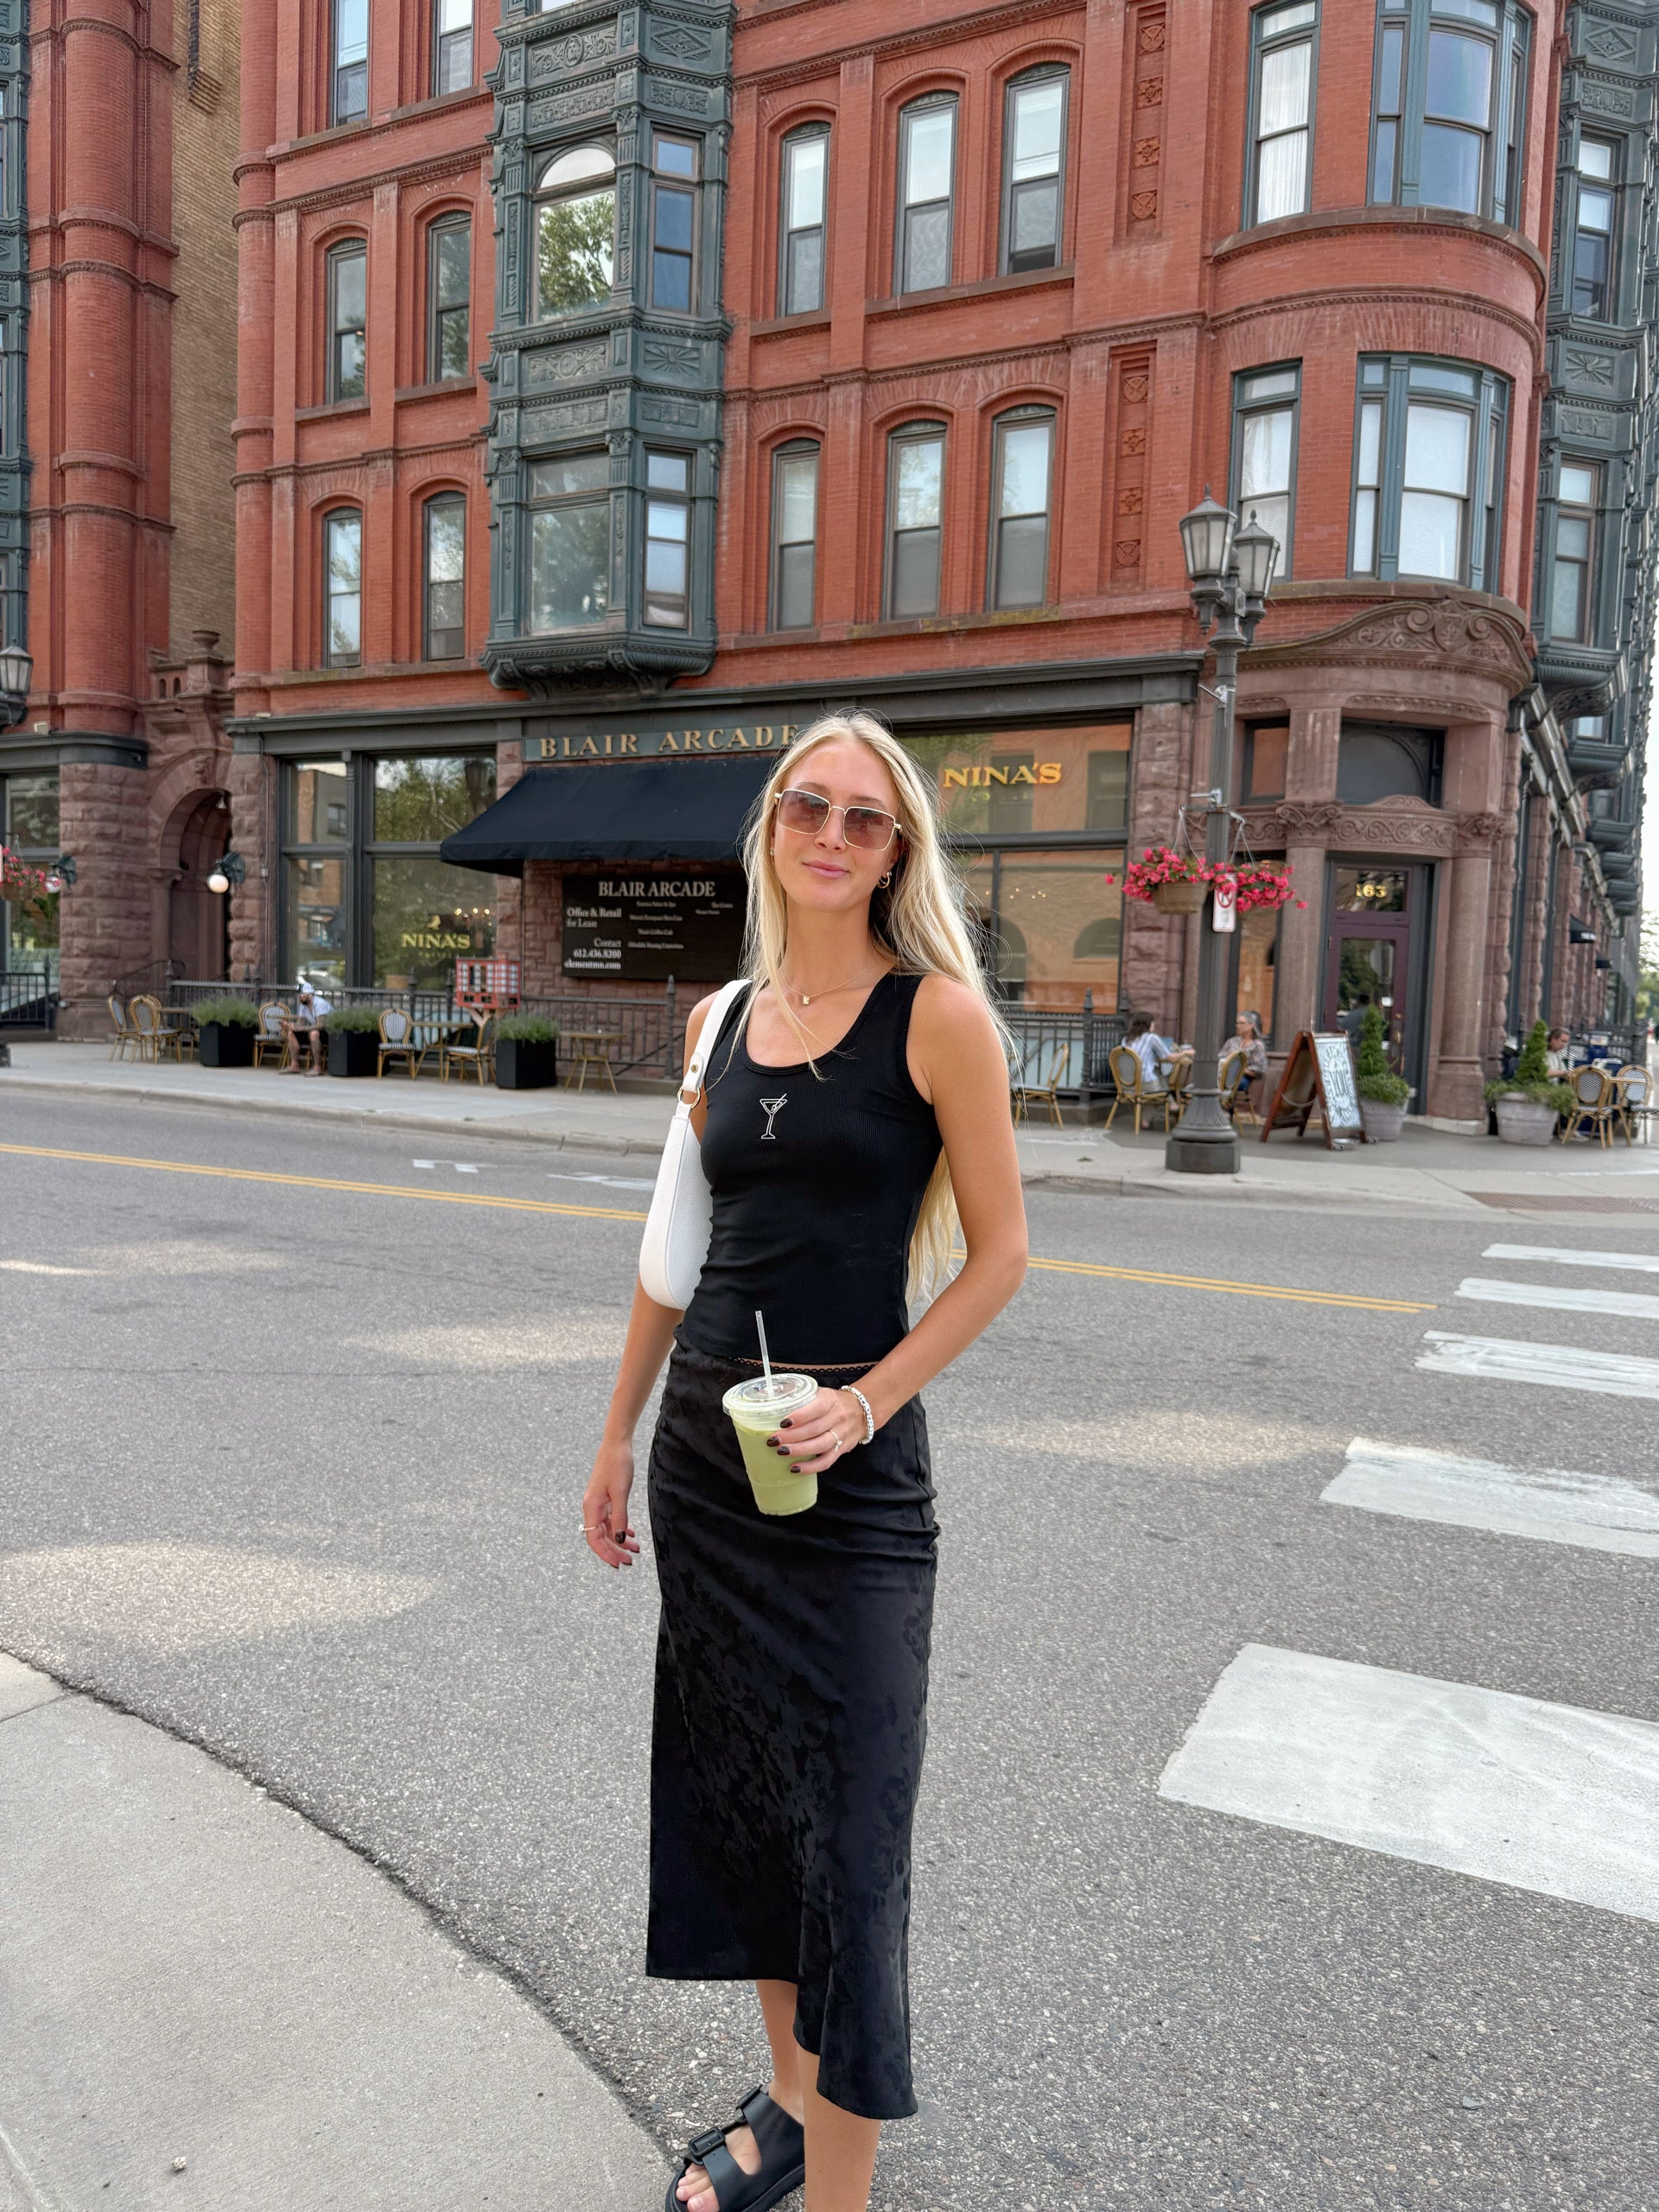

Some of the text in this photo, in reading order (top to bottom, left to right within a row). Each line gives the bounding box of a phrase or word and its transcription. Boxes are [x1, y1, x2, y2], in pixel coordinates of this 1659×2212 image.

[540, 724, 799, 758] BLAIR ARCADE
[943, 763, 1063, 787] NINA'S
[598, 881, 716, 897] BLAIR ARCADE
[401, 933, 471, 949] NINA'S
